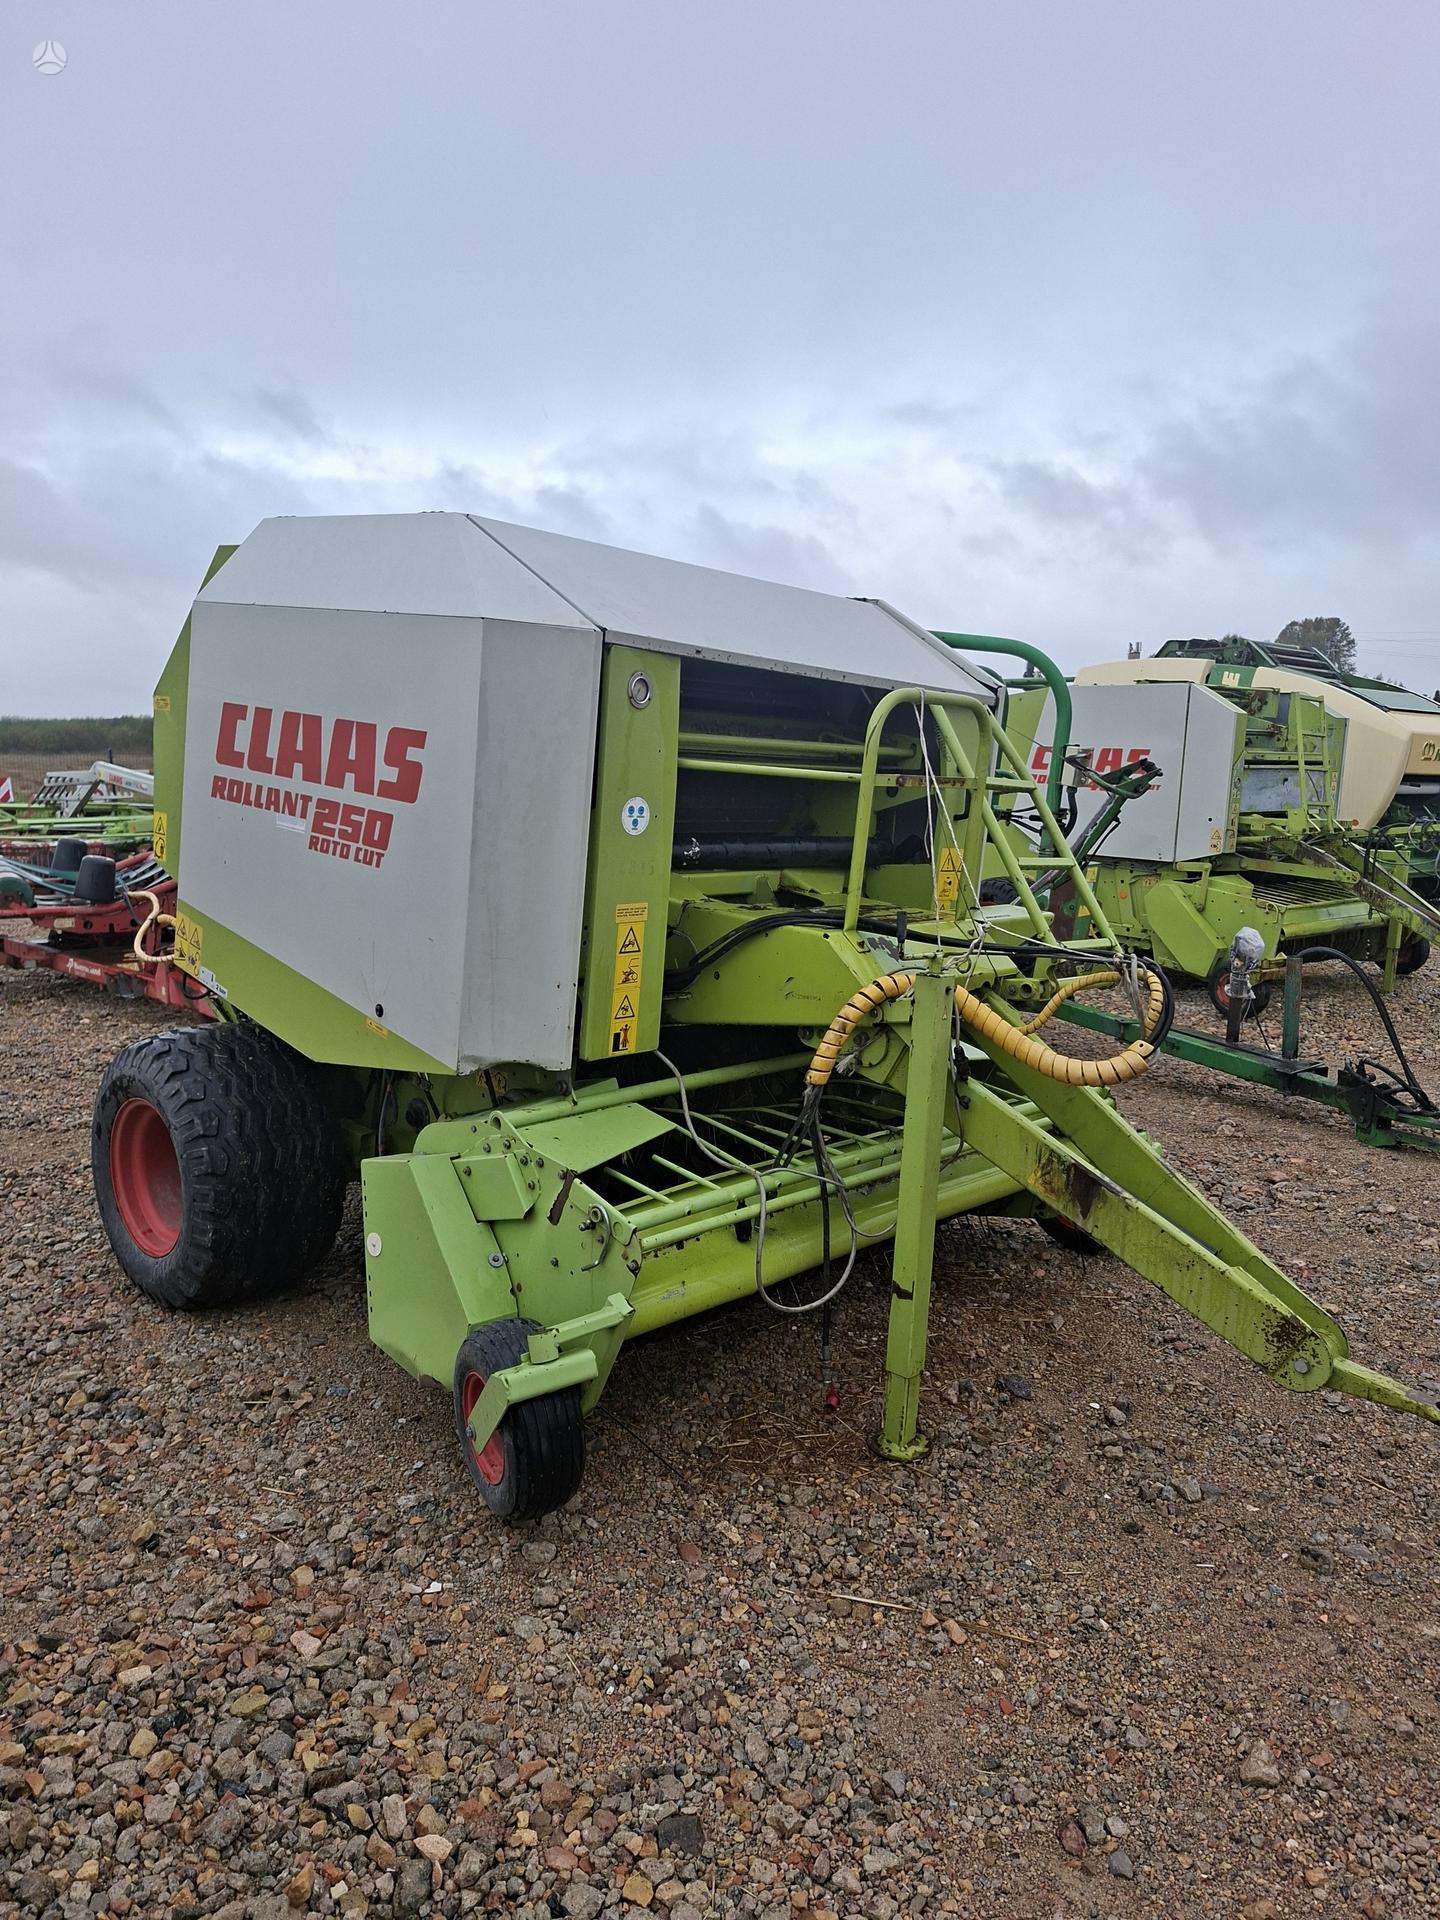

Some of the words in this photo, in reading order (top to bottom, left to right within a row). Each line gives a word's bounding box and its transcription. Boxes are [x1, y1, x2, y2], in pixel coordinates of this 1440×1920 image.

[216, 702, 427, 804] CLAAS
[211, 775, 312, 820] ROLLANT
[310, 798, 394, 851] 250
[308, 835, 350, 859] ROTO
[353, 846, 385, 868] CUT
